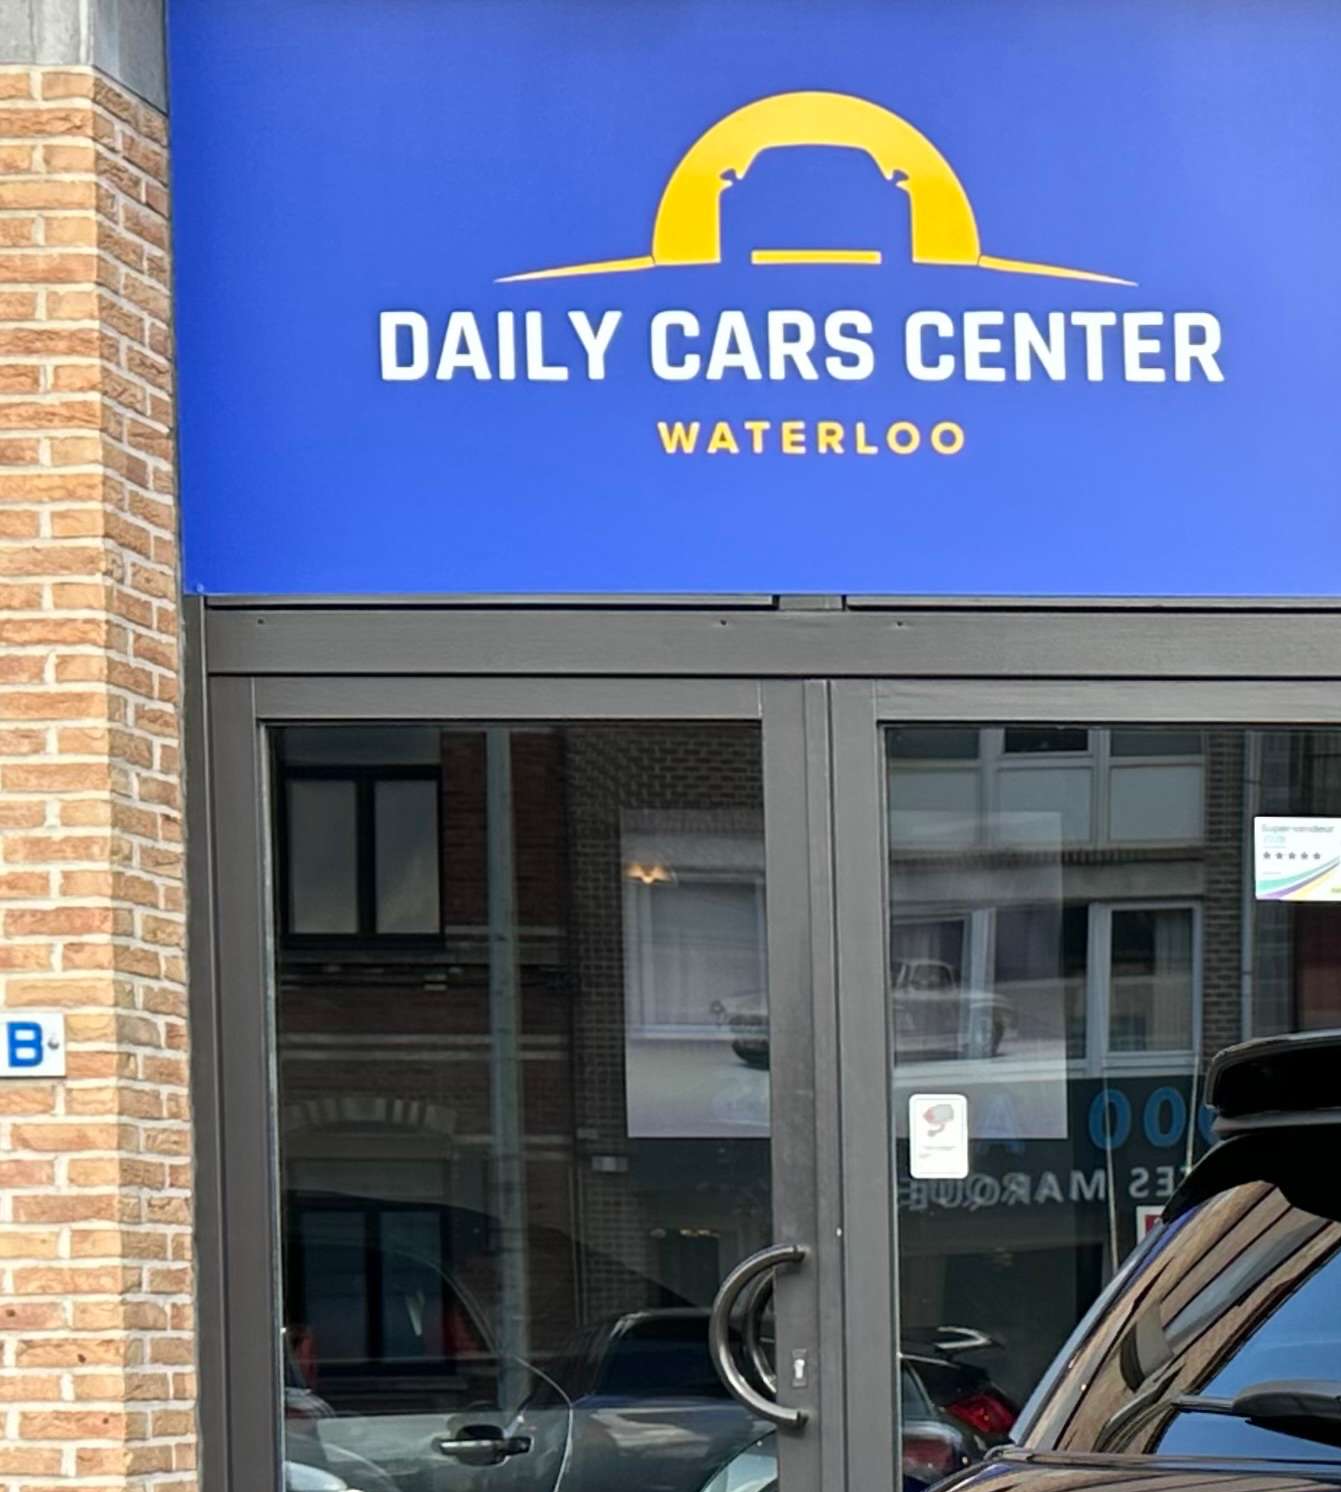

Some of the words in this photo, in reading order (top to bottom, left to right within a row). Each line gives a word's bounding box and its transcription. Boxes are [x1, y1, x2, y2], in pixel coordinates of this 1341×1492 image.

[379, 310, 623, 382] DAILY
[650, 310, 876, 382] CARS
[904, 310, 1226, 384] CENTER
[656, 420, 967, 456] WATERLOO
[6, 1021, 44, 1068] B
